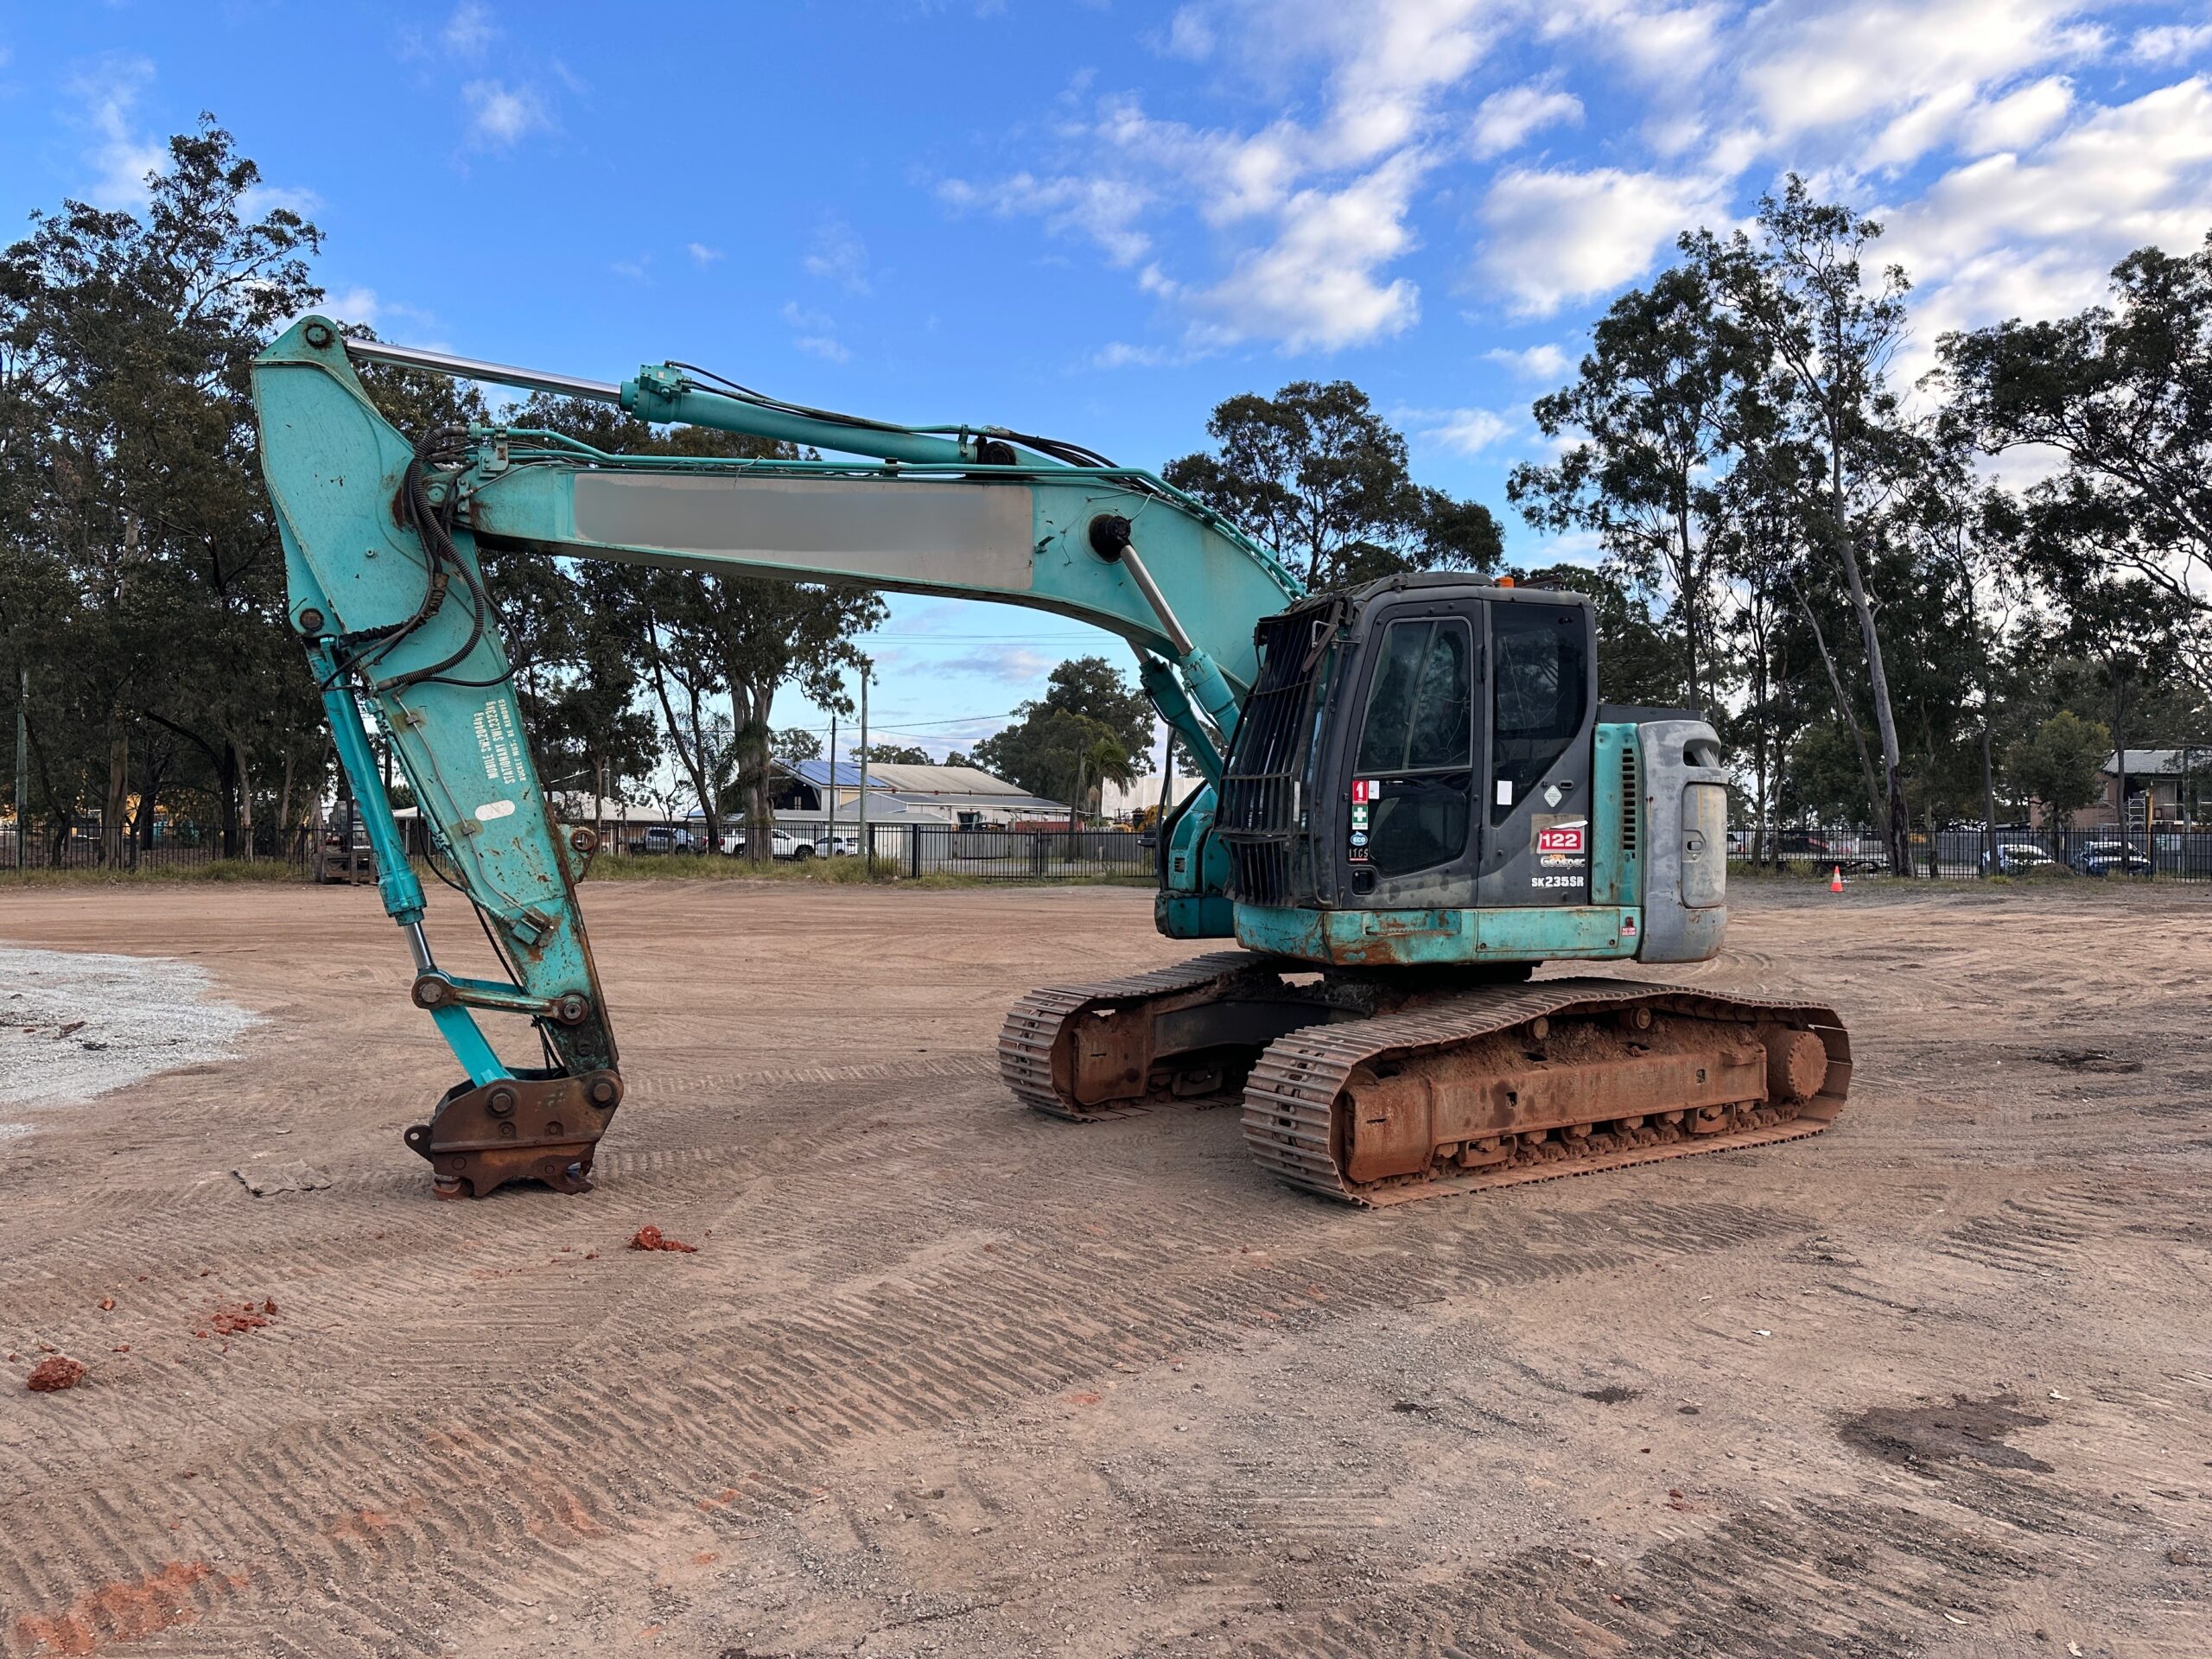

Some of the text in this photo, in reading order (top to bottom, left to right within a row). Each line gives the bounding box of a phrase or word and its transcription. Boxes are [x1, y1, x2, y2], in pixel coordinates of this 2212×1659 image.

[498, 699, 512, 727] REMOVED
[486, 701, 515, 784] STATIONARY SWL2323kg
[511, 740, 519, 756] MUS
[483, 754, 499, 779] MOBILE
[1542, 833, 1578, 848] 122
[1531, 875, 1584, 887] SK235SR
